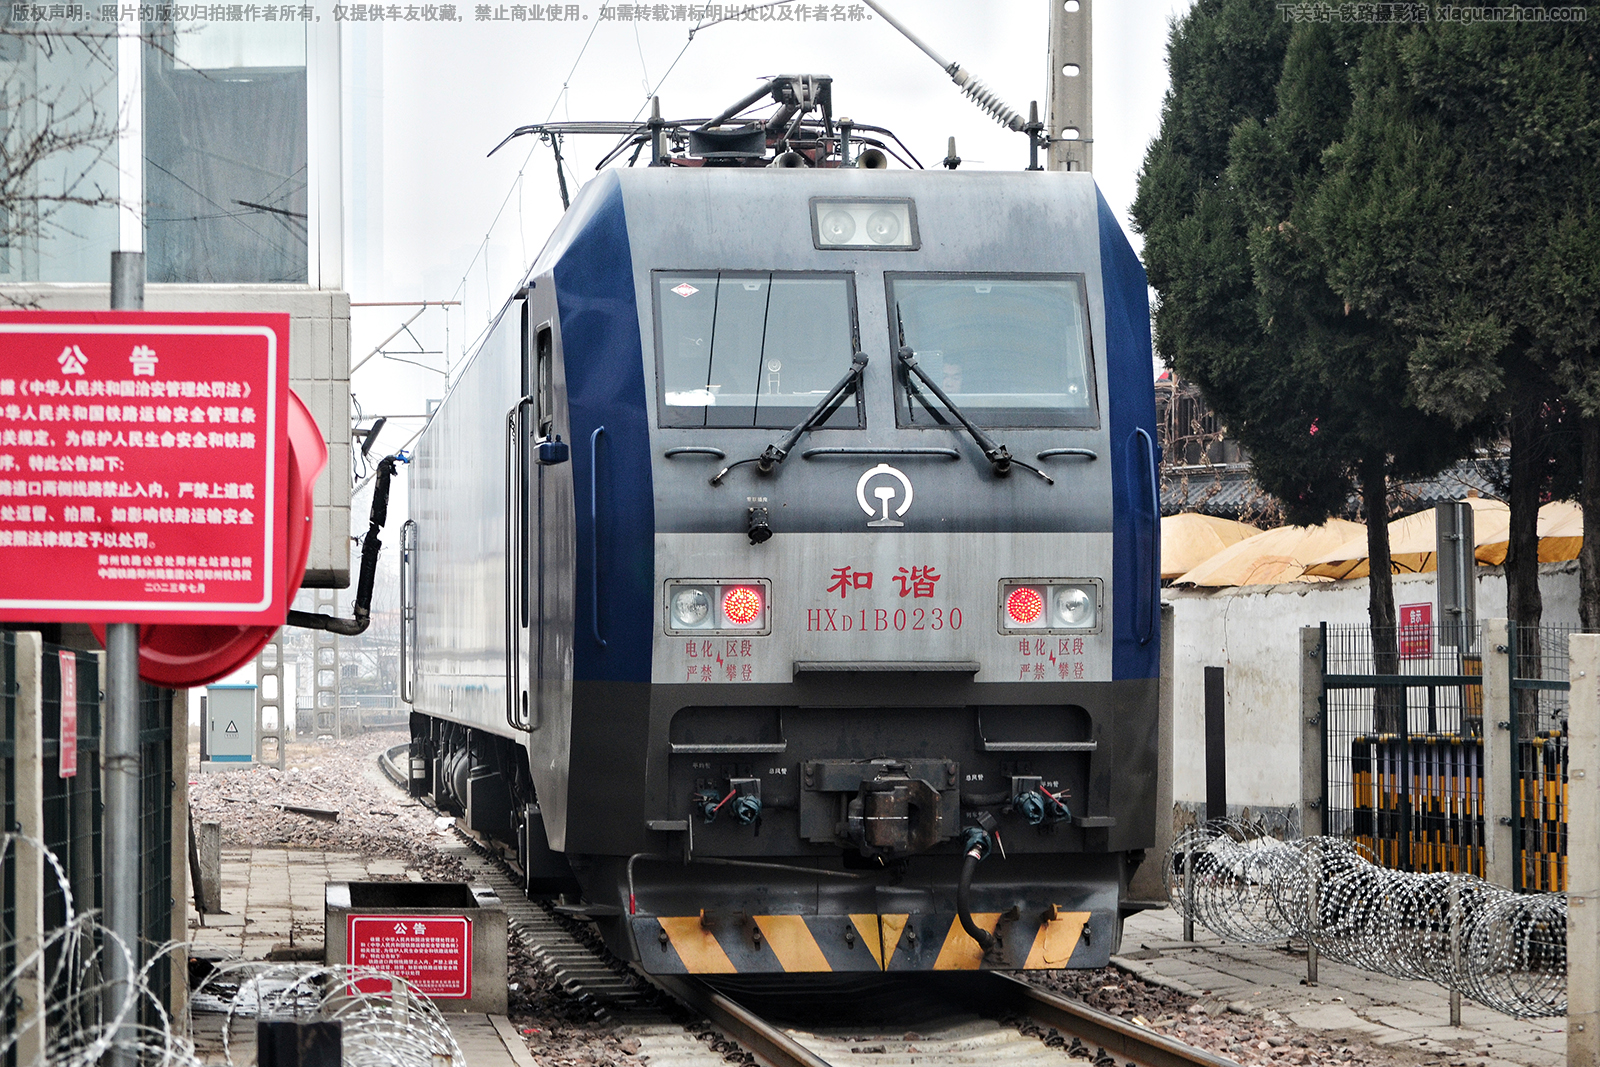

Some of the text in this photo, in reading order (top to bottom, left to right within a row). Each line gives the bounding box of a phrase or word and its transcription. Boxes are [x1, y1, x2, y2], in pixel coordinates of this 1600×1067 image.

[0, 404, 257, 424] 华人民共和国铁路运输安全管理条
[826, 565, 942, 599] 和谐
